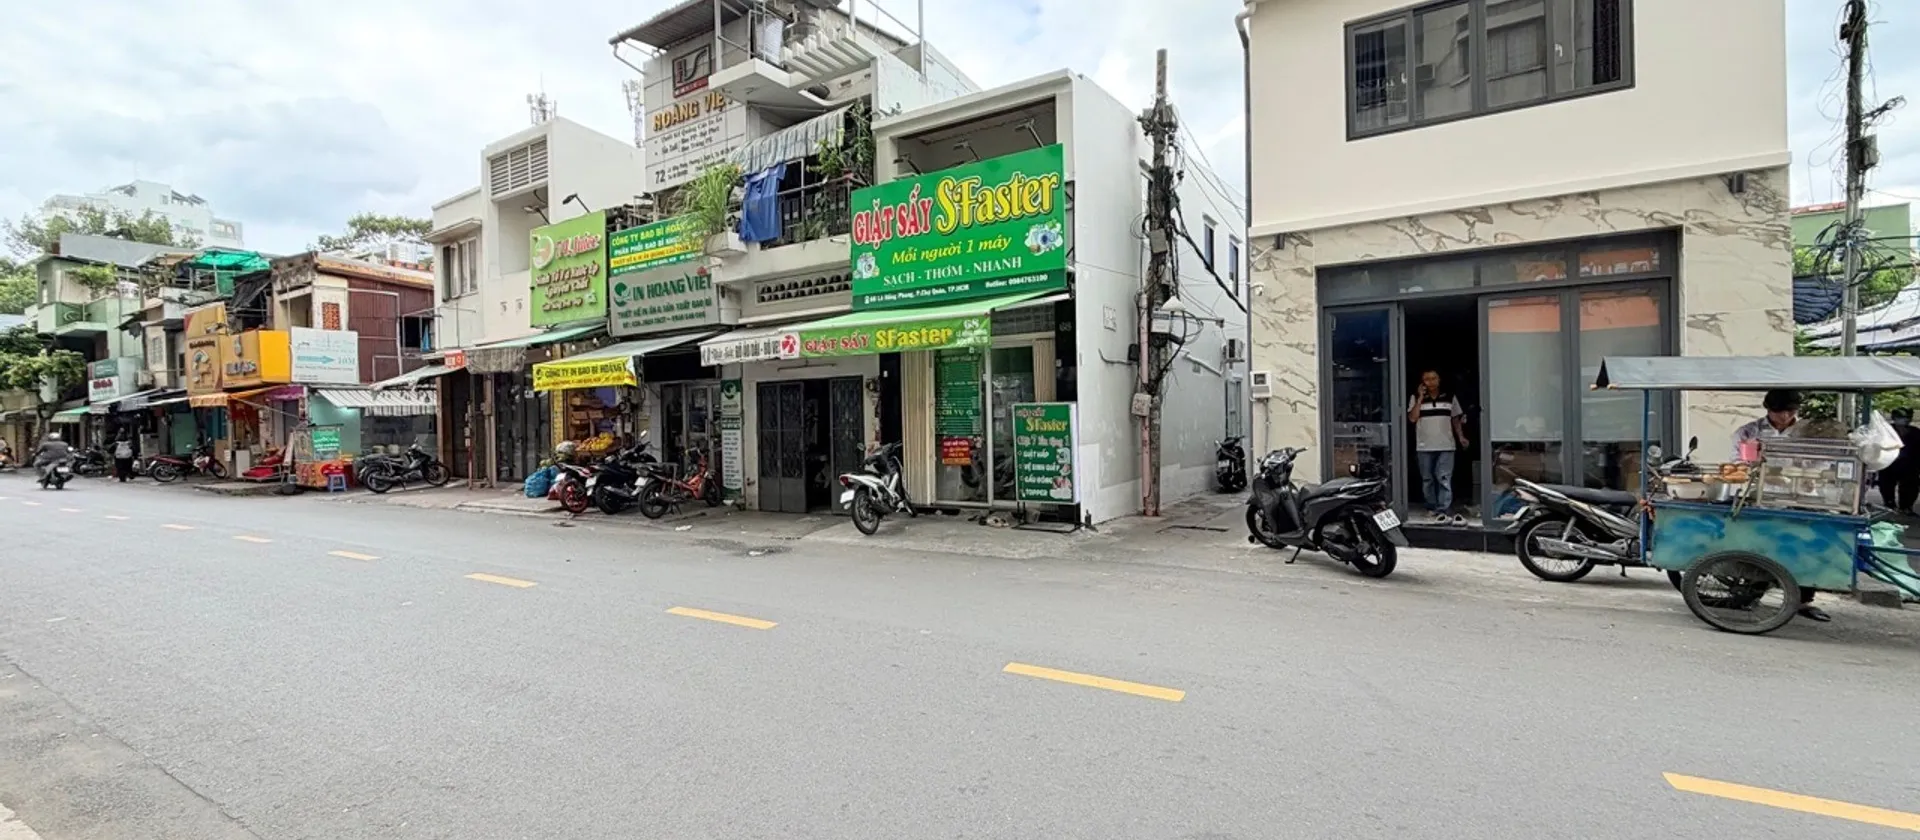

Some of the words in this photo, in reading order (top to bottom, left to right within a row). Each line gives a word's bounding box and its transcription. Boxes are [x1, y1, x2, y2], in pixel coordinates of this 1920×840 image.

[653, 101, 699, 132] HOÀNG
[705, 90, 732, 113] VIỆ
[655, 169, 666, 184] 72
[853, 198, 895, 249] GIẶT
[897, 183, 934, 237] SẤY
[936, 172, 1060, 235] SFaster
[892, 245, 916, 265] Mỗi
[920, 243, 962, 262] người
[966, 240, 973, 254] 1
[978, 234, 1012, 250] máy
[883, 271, 915, 288] SẠCH
[924, 265, 963, 280] THƠM
[973, 256, 1022, 274] NHANH
[633, 286, 645, 301] IN
[805, 336, 836, 352] GIẶT
[840, 331, 872, 349] SẤY
[875, 326, 953, 349] SFaster
